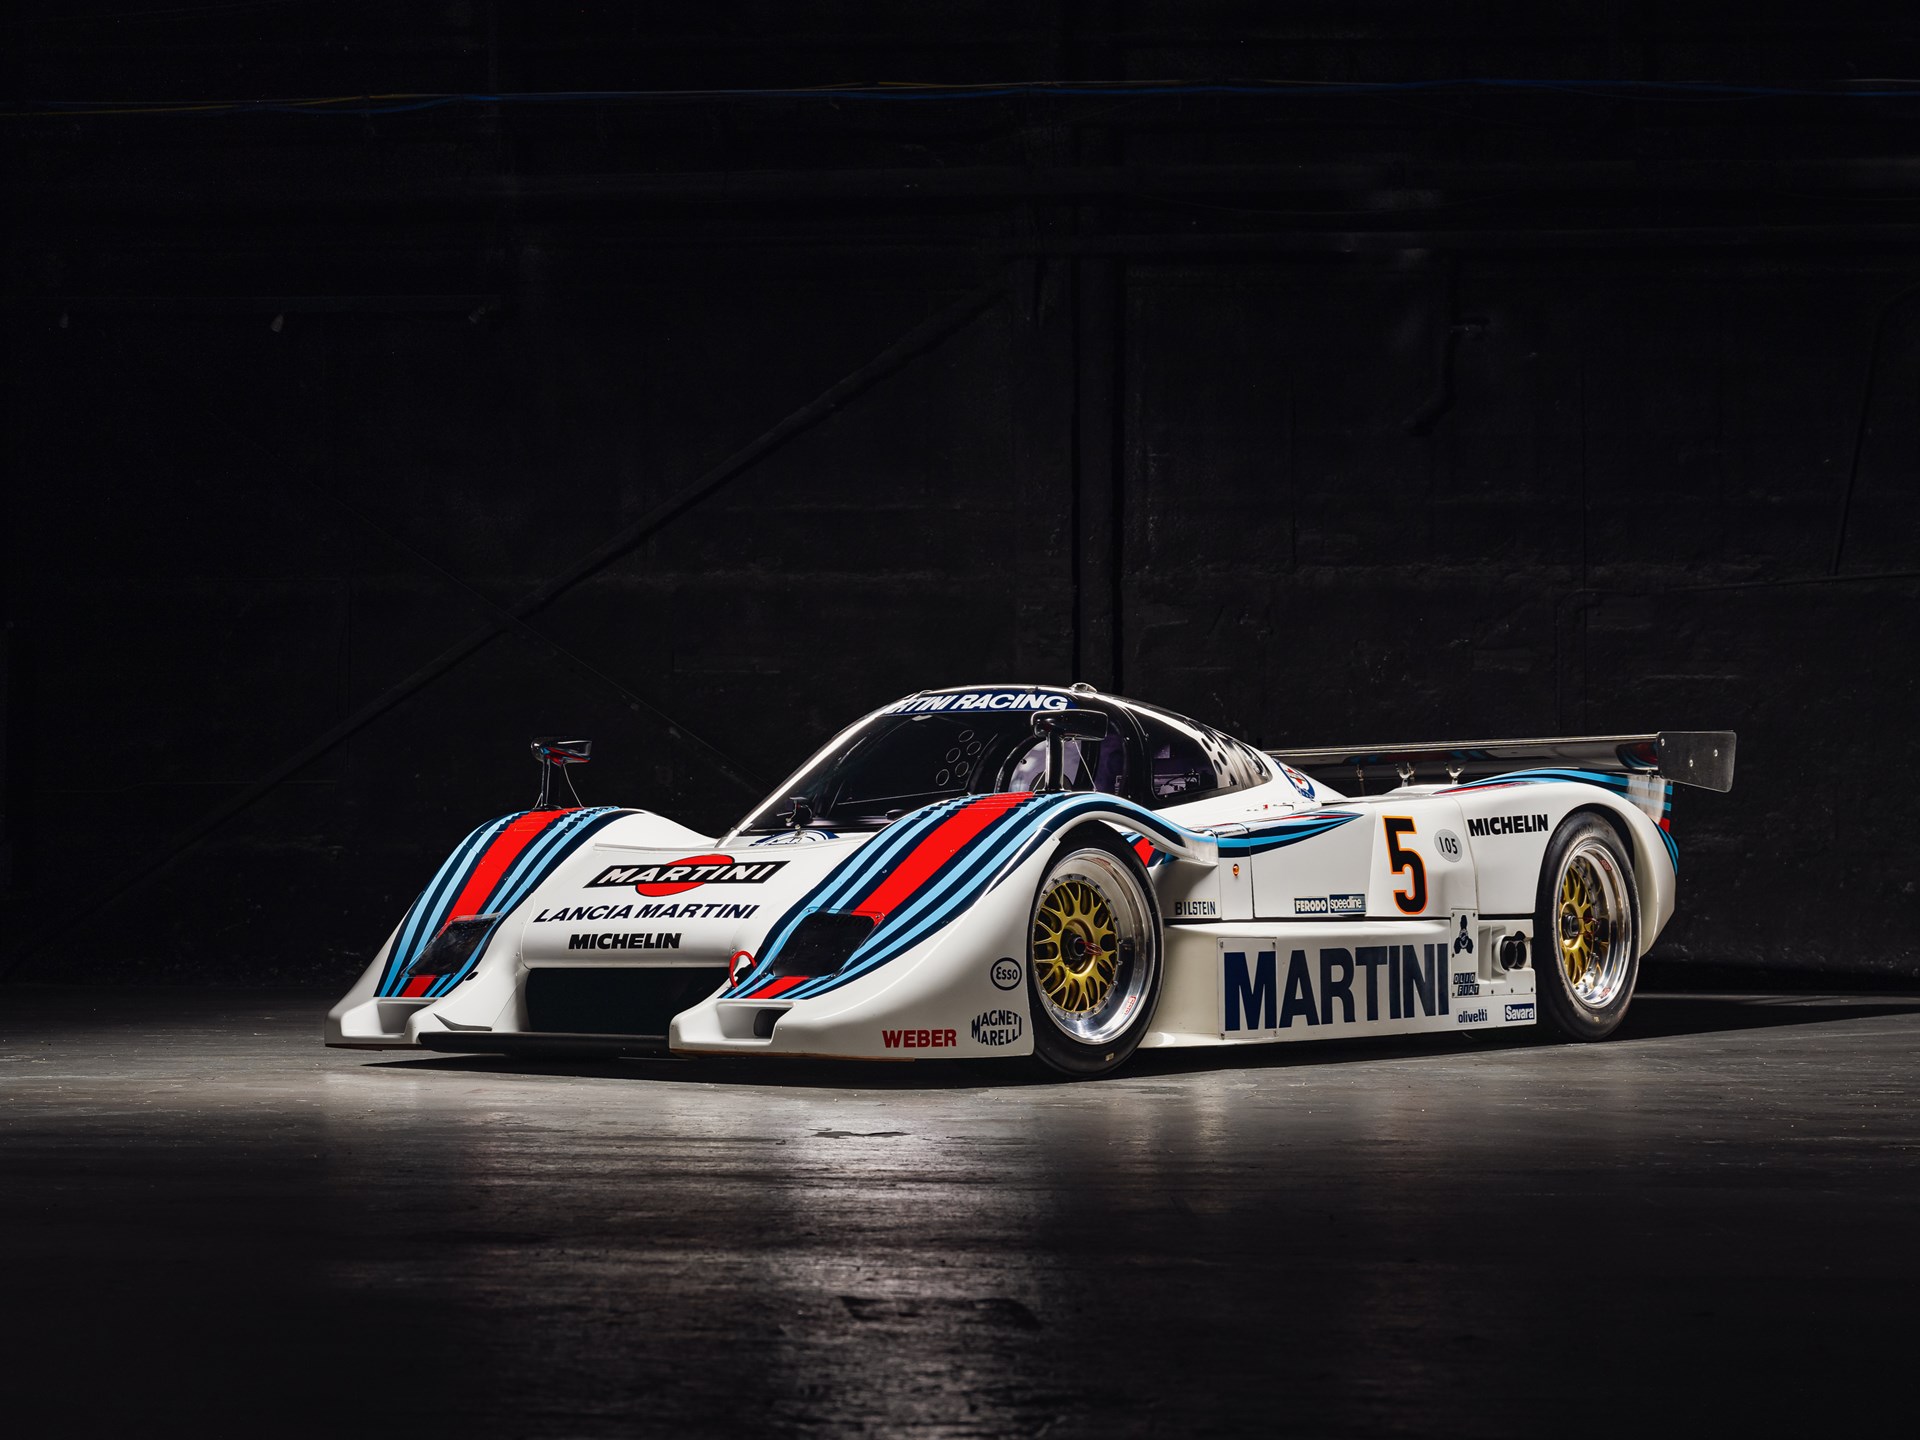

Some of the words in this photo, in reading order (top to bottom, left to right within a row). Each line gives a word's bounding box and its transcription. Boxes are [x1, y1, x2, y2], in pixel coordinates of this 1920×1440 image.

[950, 693, 1068, 711] RACING
[1467, 814, 1549, 836] MICHELIN
[597, 864, 776, 884] MARTINI
[1382, 815, 1428, 915] 5
[1175, 901, 1216, 916] BILSTEIN
[1295, 900, 1327, 912] FERODO
[1330, 896, 1362, 912] speedline
[533, 905, 634, 923] LANCIA
[634, 904, 760, 919] MARTINI
[568, 933, 682, 950] MICHELIN
[1224, 943, 1449, 1031] MARTINI
[1453, 972, 1476, 984] OLIO
[1458, 984, 1479, 996] FIAT
[971, 1010, 1022, 1029] MAGNETI
[1458, 1008, 1488, 1023] olivetti
[1505, 1005, 1534, 1020] Savara
[882, 1029, 957, 1048] WEBER
[971, 1027, 1022, 1046] MARELLI
